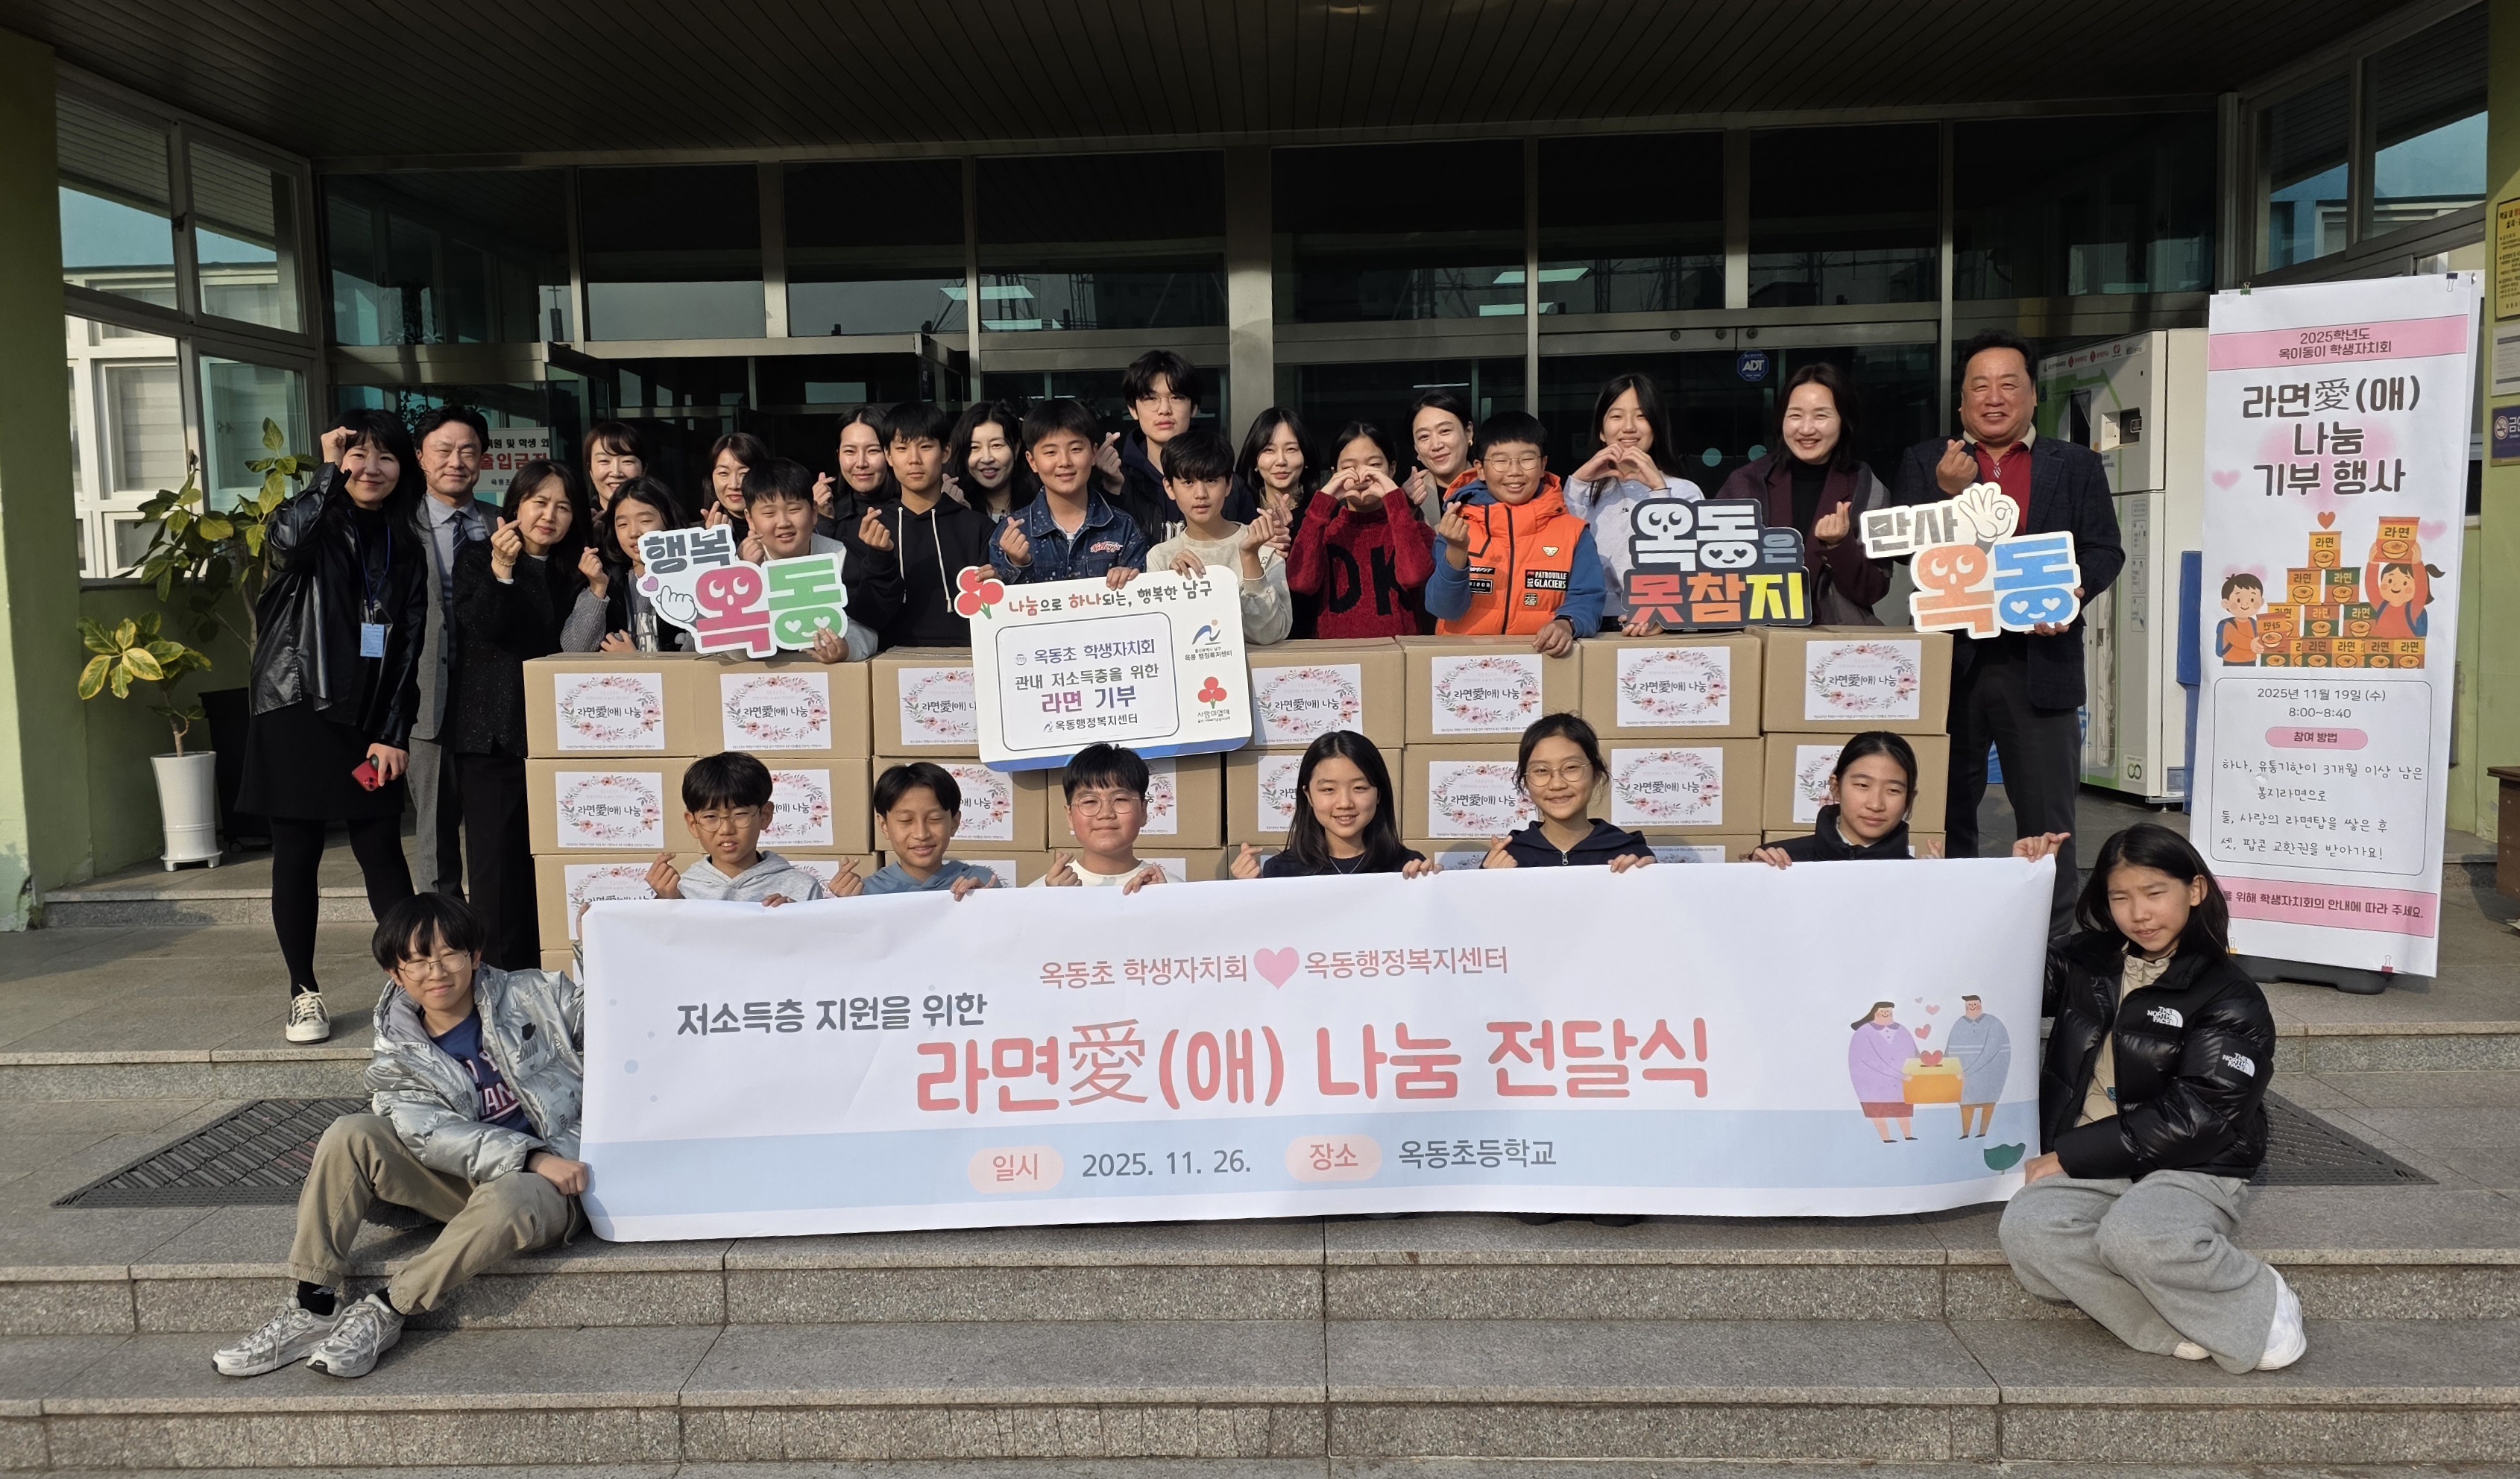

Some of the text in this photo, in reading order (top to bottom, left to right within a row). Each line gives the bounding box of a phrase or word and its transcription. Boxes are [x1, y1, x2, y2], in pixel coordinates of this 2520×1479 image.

[2300, 328, 2371, 344] 2025학년도
[2278, 341, 2392, 360] 옥이동이 학생자치회
[1742, 359, 1765, 371] ADT
[2243, 375, 2420, 418] 라면愛(애)
[518, 438, 536, 448] 학생
[2293, 421, 2364, 455] 나눔
[2253, 458, 2406, 496] 기부 행사
[1867, 505, 1958, 553] 만사
[2384, 527, 2410, 538] 라면
[2315, 537, 2334, 548] 라면
[643, 529, 730, 575] 행복
[1534, 578, 1566, 589] GLACIERS
[1917, 537, 2075, 634] 옥동
[2294, 573, 2311, 584] 라면
[2334, 573, 2352, 584] 라면
[696, 558, 842, 653] 옥동
[1009, 579, 1212, 616] 나눔으로 하나되는, 행복한 남구
[2352, 608, 2370, 618] 라면
[1034, 639, 1155, 664] 옥동초 학생자치회
[2309, 642, 2326, 652] 라면
[2338, 642, 2355, 652] 라면
[2372, 642, 2389, 652] 라면
[2401, 642, 2419, 653] 라면
[1015, 663, 1159, 690] 관내 저소득층을 위한
[1042, 685, 1136, 713] 라면 기부
[2258, 688, 2386, 702] 2025년 11월 19일 (수)
[2289, 707, 2351, 719] 8:00~8:40
[1056, 713, 1138, 731] 옥동행정복지센터
[2293, 731, 2338, 743] 참여 방법
[2223, 760, 2423, 781] 하나, 유통기한이 3개월 이상 남은
[2258, 787, 2327, 801] 봉지라면으로
[2240, 813, 2279, 825] 사랑의
[2285, 817, 2337, 831] 라면탑을
[2344, 819, 2369, 832] 쌓은
[2378, 819, 2387, 833] 후
[2243, 839, 2266, 852] 팝콘
[2273, 841, 2318, 856] 교환권을
[2325, 845, 2383, 860] 받아가요!
[2235, 891, 2257, 904] 위해
[2259, 893, 2325, 909] 학생자치회의
[2328, 900, 2362, 912] 안내에
[2365, 902, 2388, 915] 따라
[2391, 904, 2423, 918] 주세요.
[1039, 945, 1509, 990] 옥동초 학생자치회 옥동행정복지센터
[676, 992, 988, 1036] 저소득층 지원을 위한
[2147, 1009, 2170, 1020] NORTH
[2153, 1016, 2171, 1025] FACE
[916, 1017, 1709, 1114] 라면愛(애) 나눔 전달식
[2223, 1054, 2246, 1067] NORTH
[2234, 1053, 2247, 1062] THE
[992, 1139, 1557, 1182] 일시 2025. 11. 26. 장소 옥동초등학교
